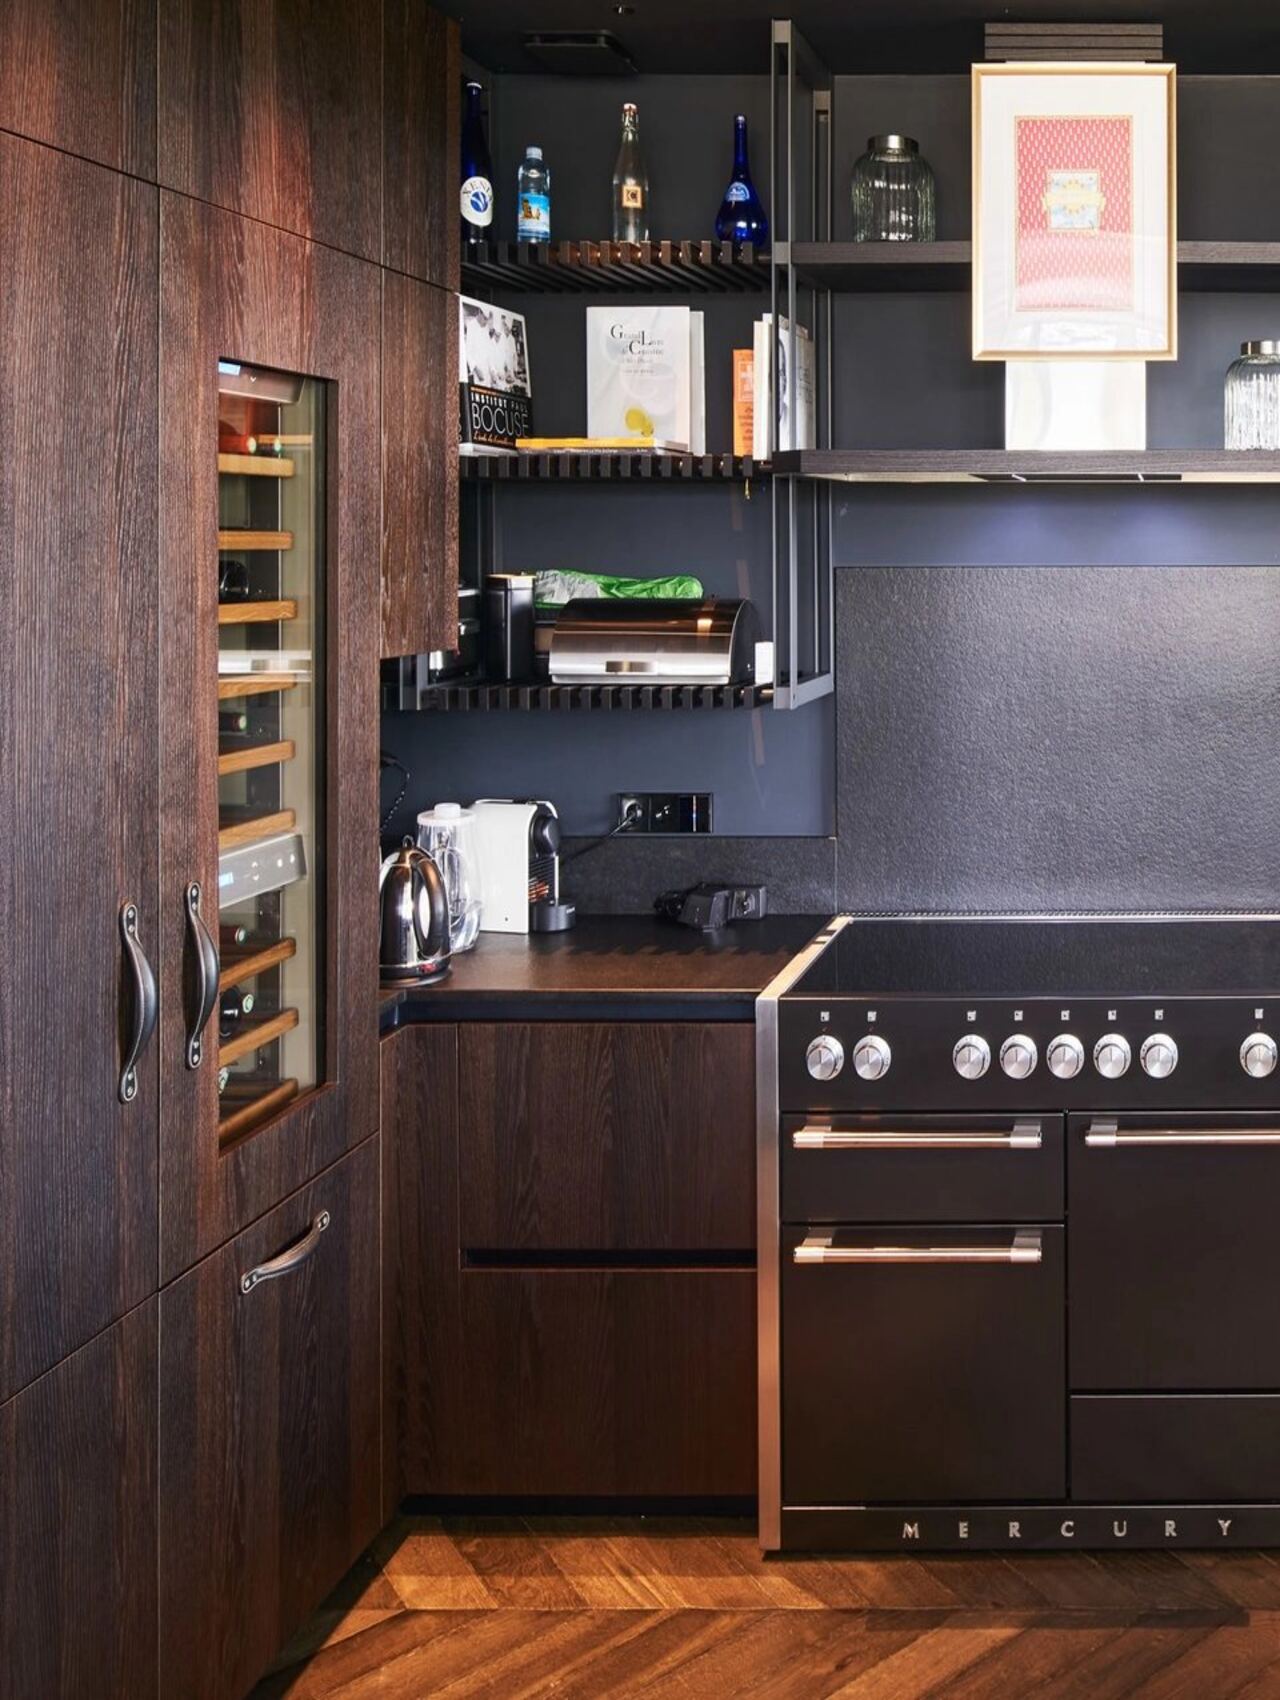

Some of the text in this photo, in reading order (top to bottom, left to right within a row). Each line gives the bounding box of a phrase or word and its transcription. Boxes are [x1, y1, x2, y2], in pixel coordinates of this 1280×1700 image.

[471, 392, 507, 409] INSTITUT
[471, 402, 529, 438] BOCUSE
[902, 1519, 1233, 1540] MERCURY
